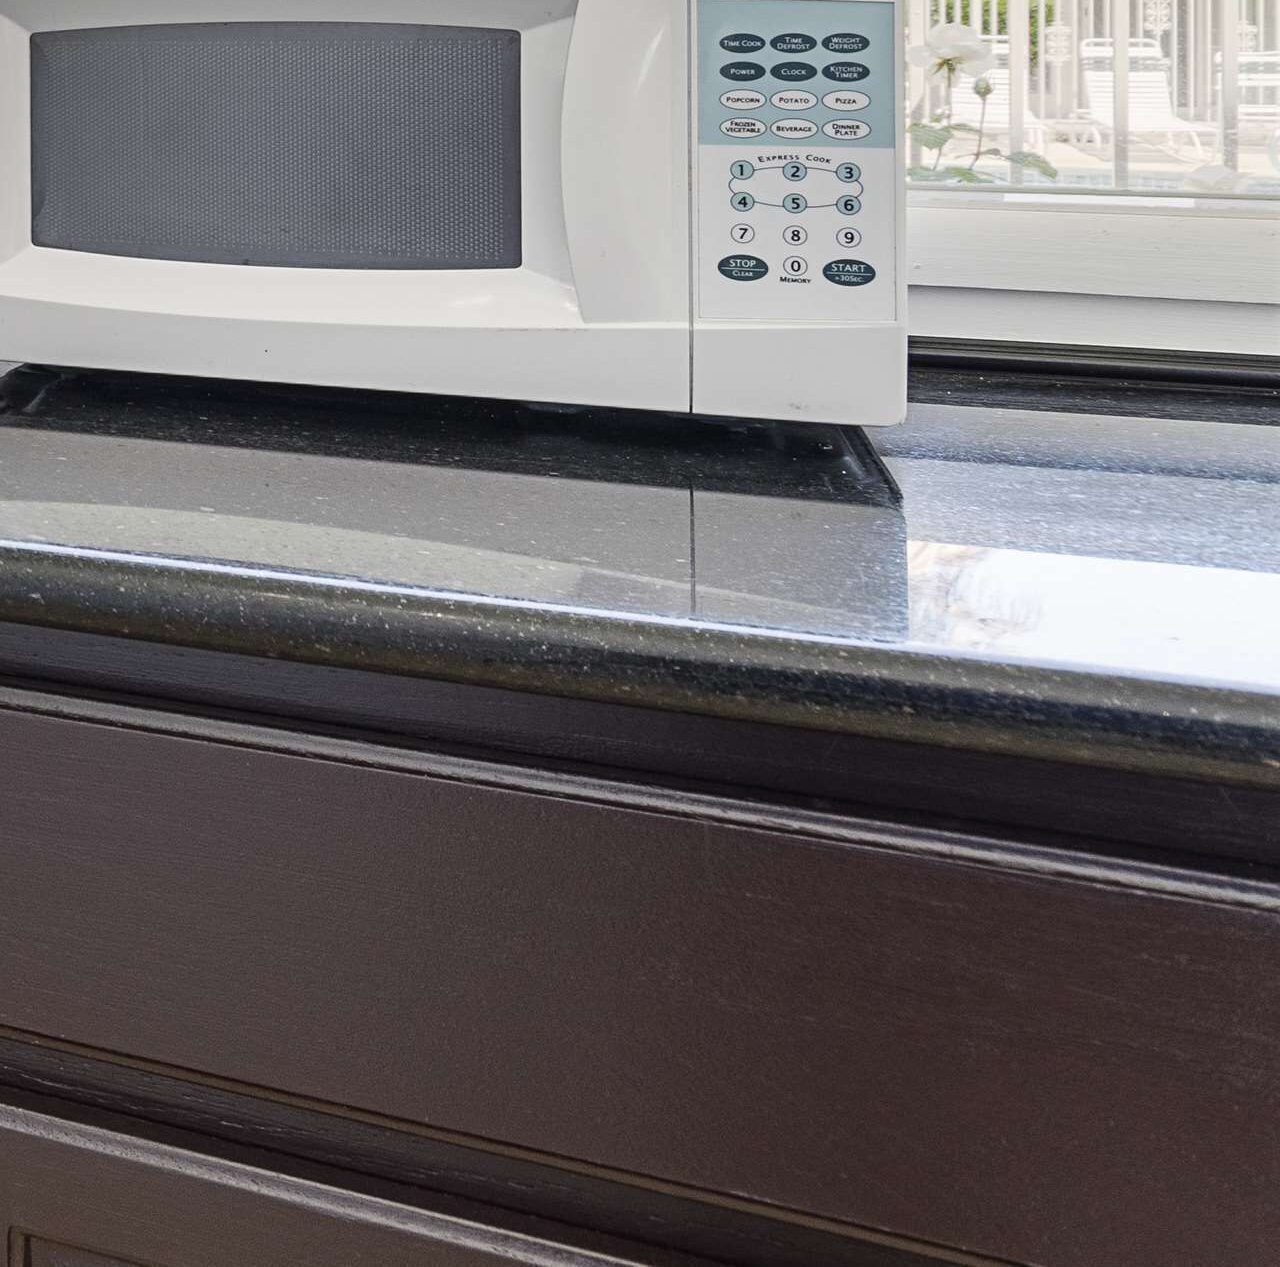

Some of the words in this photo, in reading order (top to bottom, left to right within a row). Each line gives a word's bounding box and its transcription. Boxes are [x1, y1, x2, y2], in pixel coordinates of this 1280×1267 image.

[785, 36, 802, 44] TIME
[758, 154, 800, 163] EXPRESS
[806, 154, 832, 164] COOK
[738, 165, 744, 176] 1
[791, 166, 799, 178] 2
[845, 167, 854, 179] 3
[737, 197, 747, 208] 4
[791, 198, 800, 210] 5
[845, 199, 854, 212] 6
[738, 228, 748, 239] 7
[791, 229, 800, 242] 8
[844, 232, 854, 244] 9
[729, 259, 757, 267] STOP
[791, 260, 801, 272] 0
[831, 264, 866, 273] START
